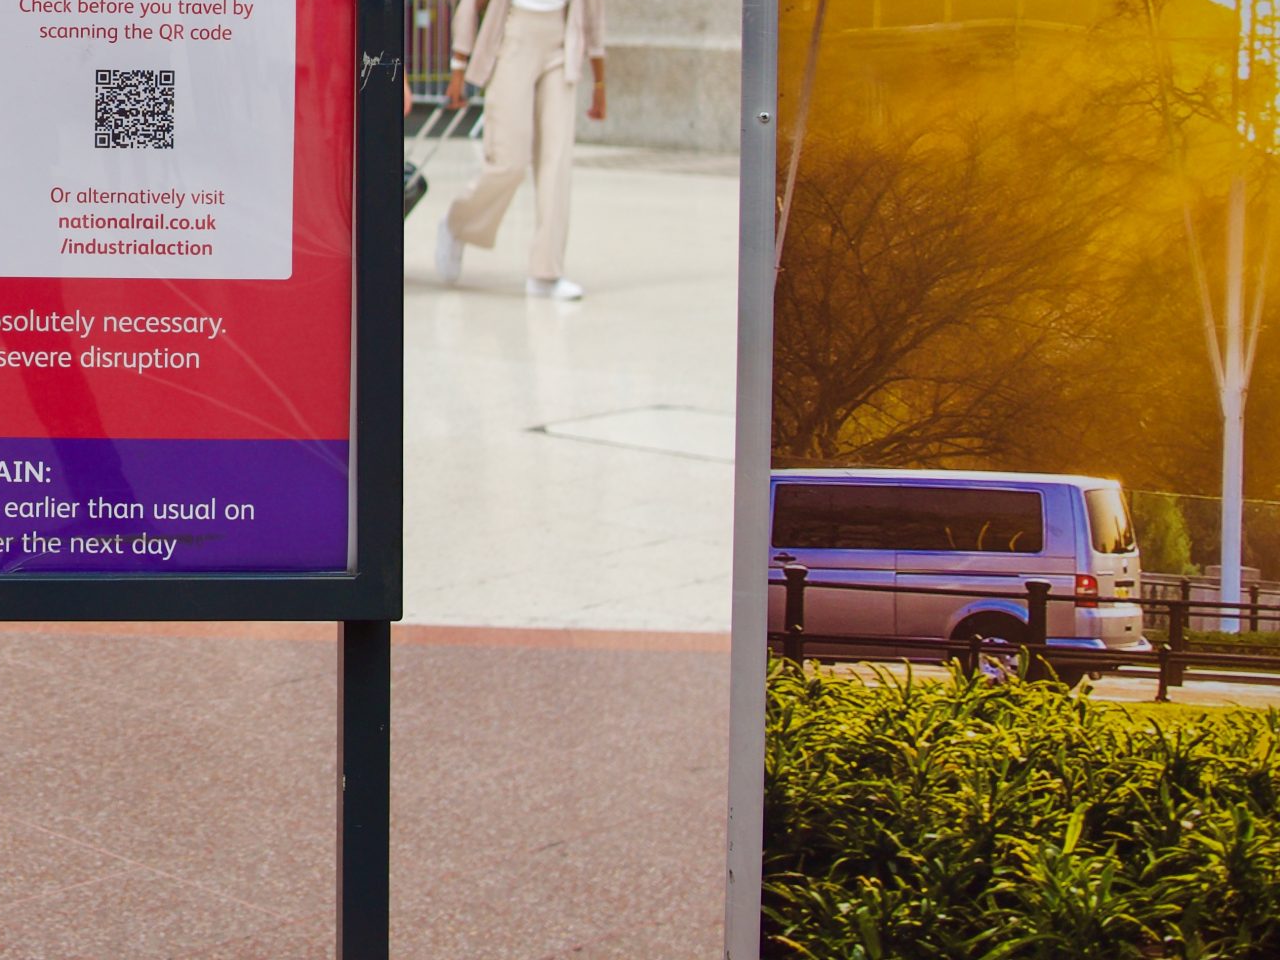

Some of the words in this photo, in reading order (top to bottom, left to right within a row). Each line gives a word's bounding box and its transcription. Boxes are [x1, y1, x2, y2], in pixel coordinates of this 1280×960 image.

[140, 3, 171, 18] you
[179, 0, 226, 14] travel
[234, 0, 253, 19] by
[40, 24, 117, 43] scanning
[125, 24, 152, 39] the
[160, 24, 183, 41] QR
[191, 25, 231, 40] code
[51, 188, 70, 203] Or
[77, 188, 185, 208] alternatively
[192, 190, 224, 204] visit
[59, 214, 215, 229] nationalrail.co.uk
[61, 239, 212, 255] /industrialaction
[104, 316, 226, 339] necessary.
[81, 346, 199, 374] disruption
[5, 496, 79, 518] earlier
[88, 497, 143, 518] than
[154, 498, 215, 519] usual
[225, 504, 254, 520] on
[22, 531, 61, 553] the
[71, 535, 123, 553] next
[132, 532, 176, 560] day
